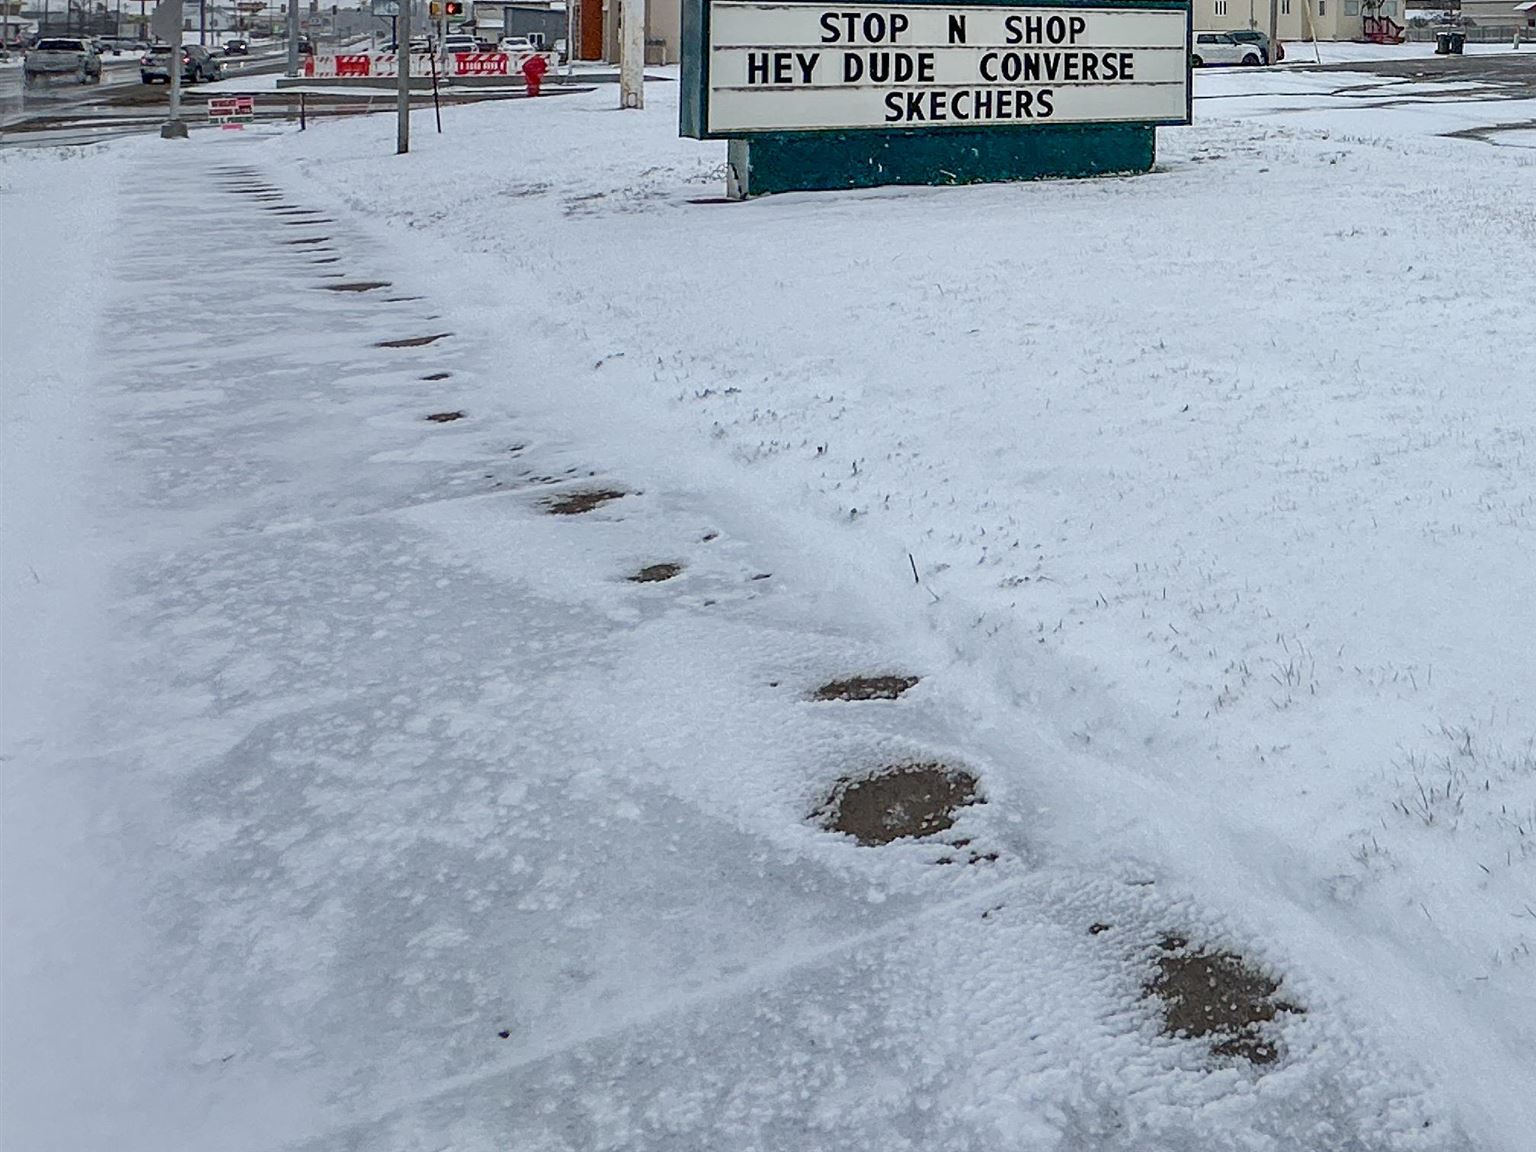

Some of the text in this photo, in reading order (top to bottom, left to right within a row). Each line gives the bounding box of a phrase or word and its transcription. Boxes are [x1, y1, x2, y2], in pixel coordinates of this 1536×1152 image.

[819, 12, 1087, 45] STOP N SHOP
[747, 51, 1135, 85] HEY DUDE CONVERSE
[884, 89, 1054, 122] SKECHERS
